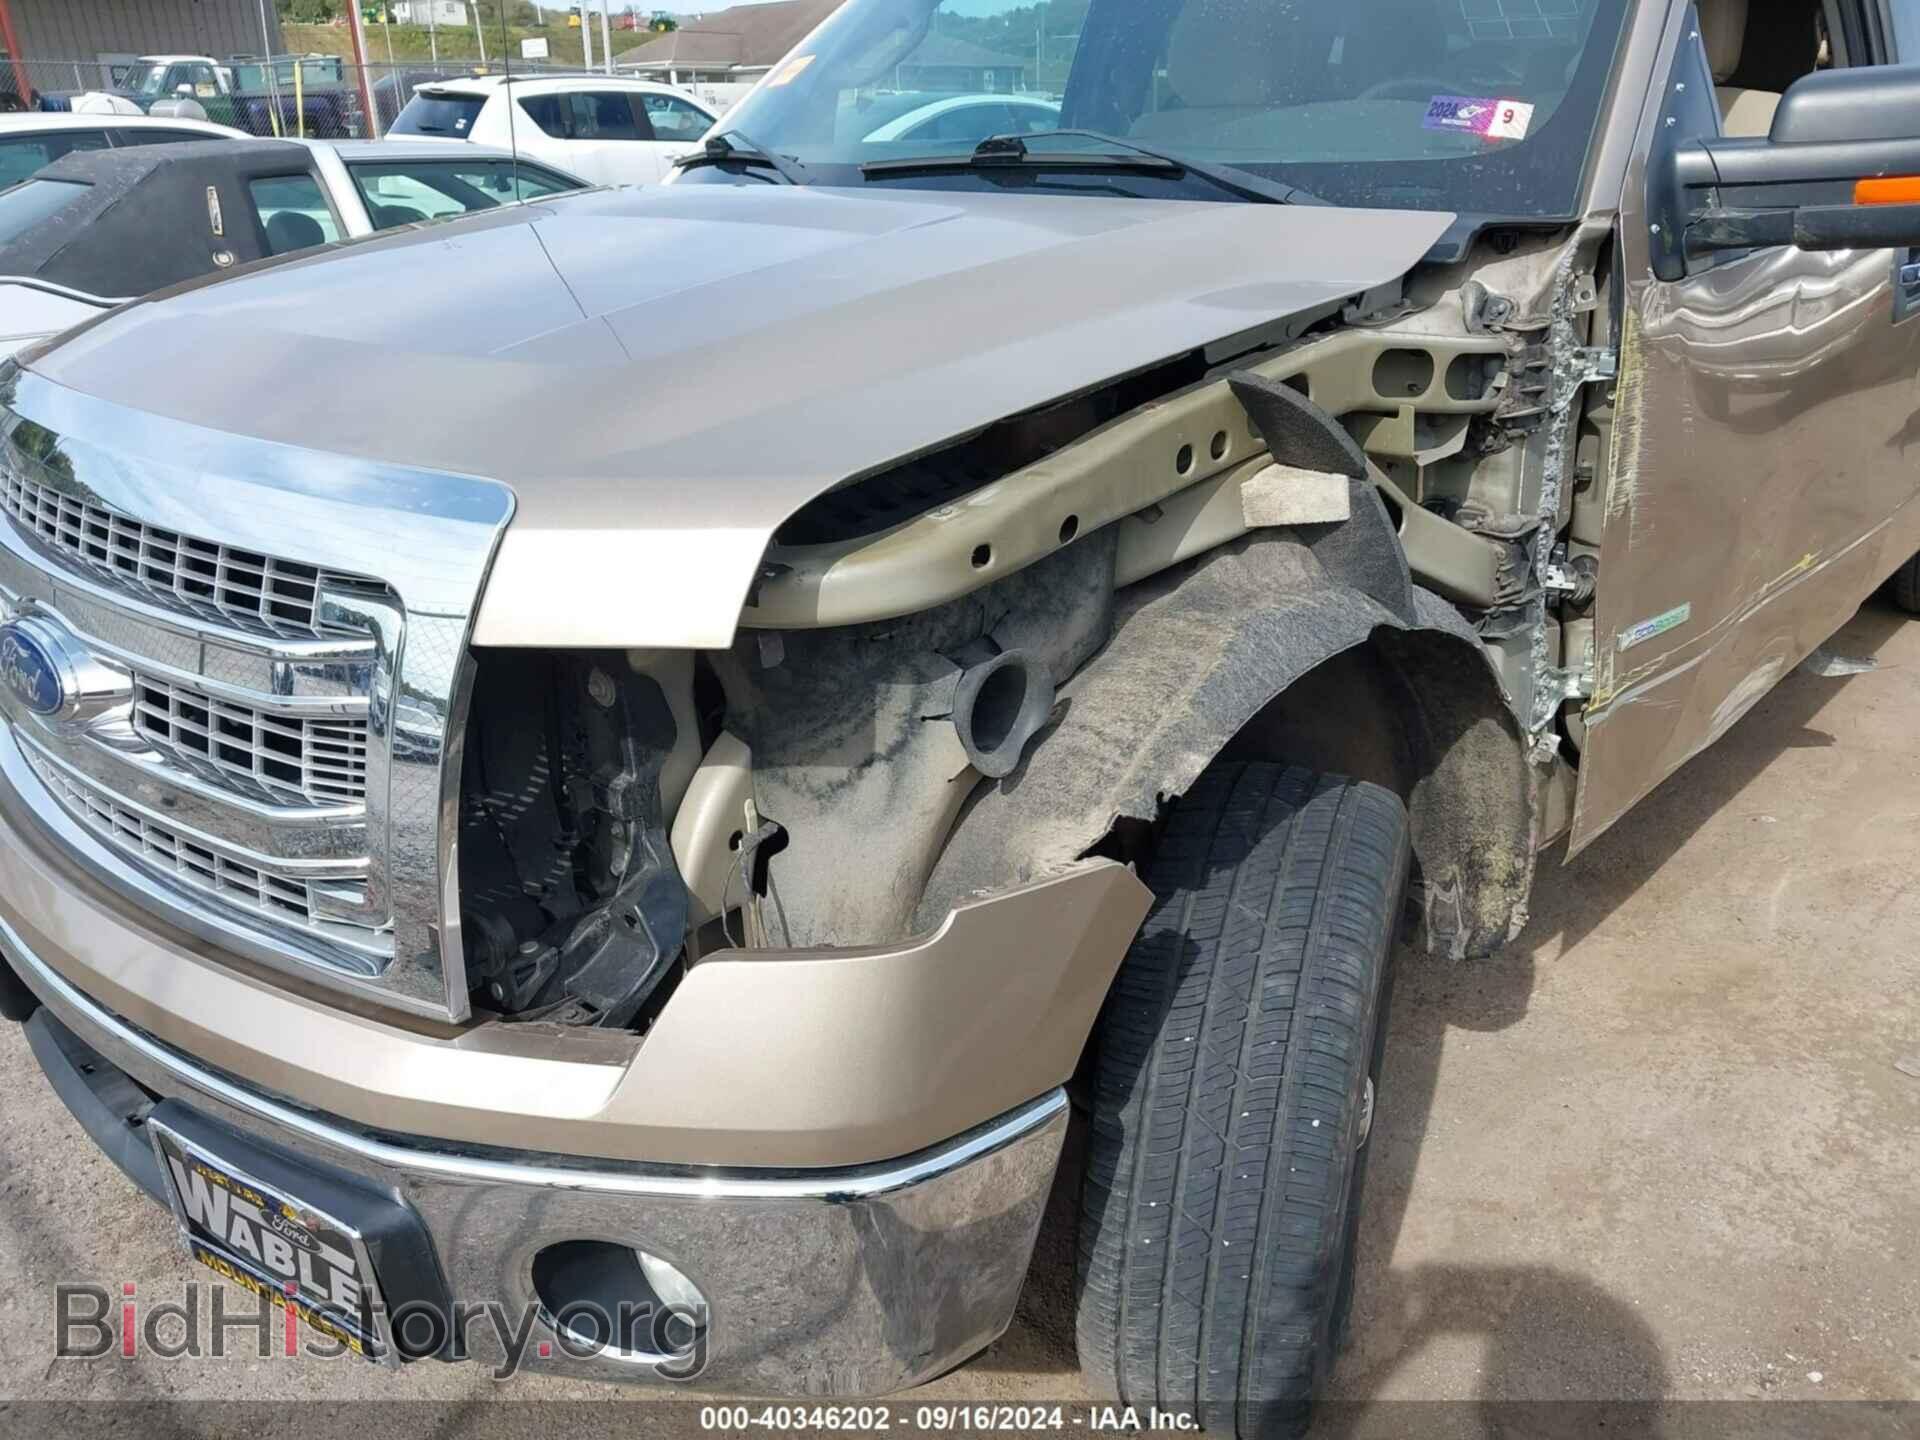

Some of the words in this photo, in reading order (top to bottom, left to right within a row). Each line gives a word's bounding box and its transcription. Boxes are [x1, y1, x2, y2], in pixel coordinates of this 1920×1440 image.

[1428, 101, 1458, 118] 2024
[1502, 108, 1515, 124] 9
[272, 1212, 311, 1249] Ford
